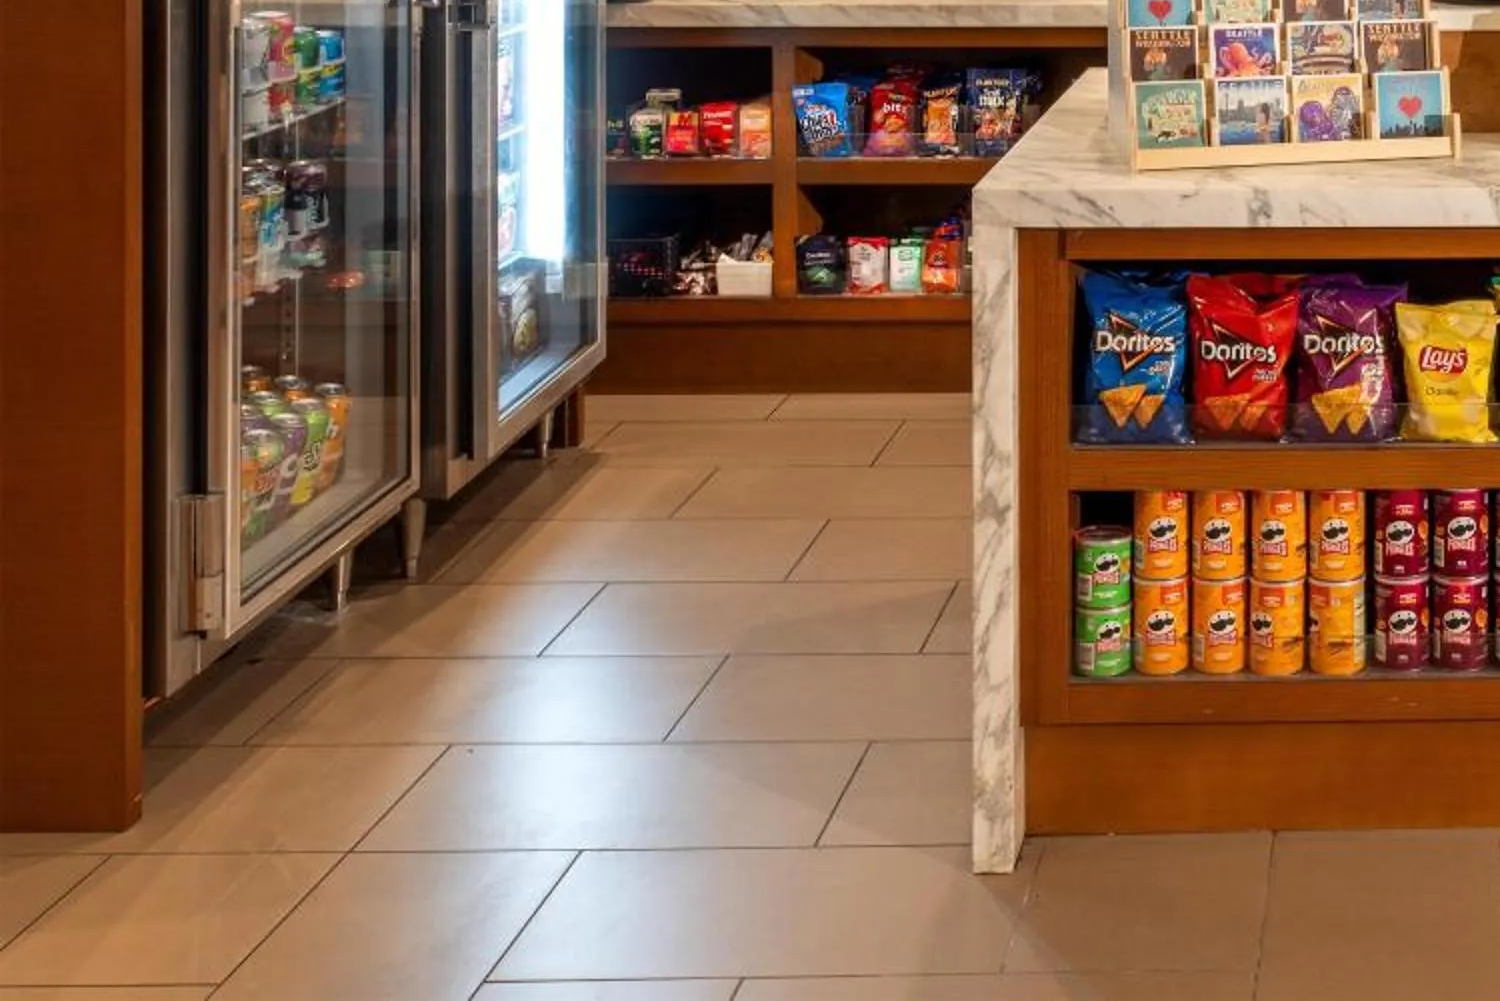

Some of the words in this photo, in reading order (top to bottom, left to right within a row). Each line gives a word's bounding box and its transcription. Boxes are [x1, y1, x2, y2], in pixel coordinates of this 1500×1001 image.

[1096, 330, 1175, 353] Doritos
[1201, 340, 1276, 363] Doritos
[1304, 333, 1384, 354] Doritos
[1422, 346, 1466, 373] Lay's
